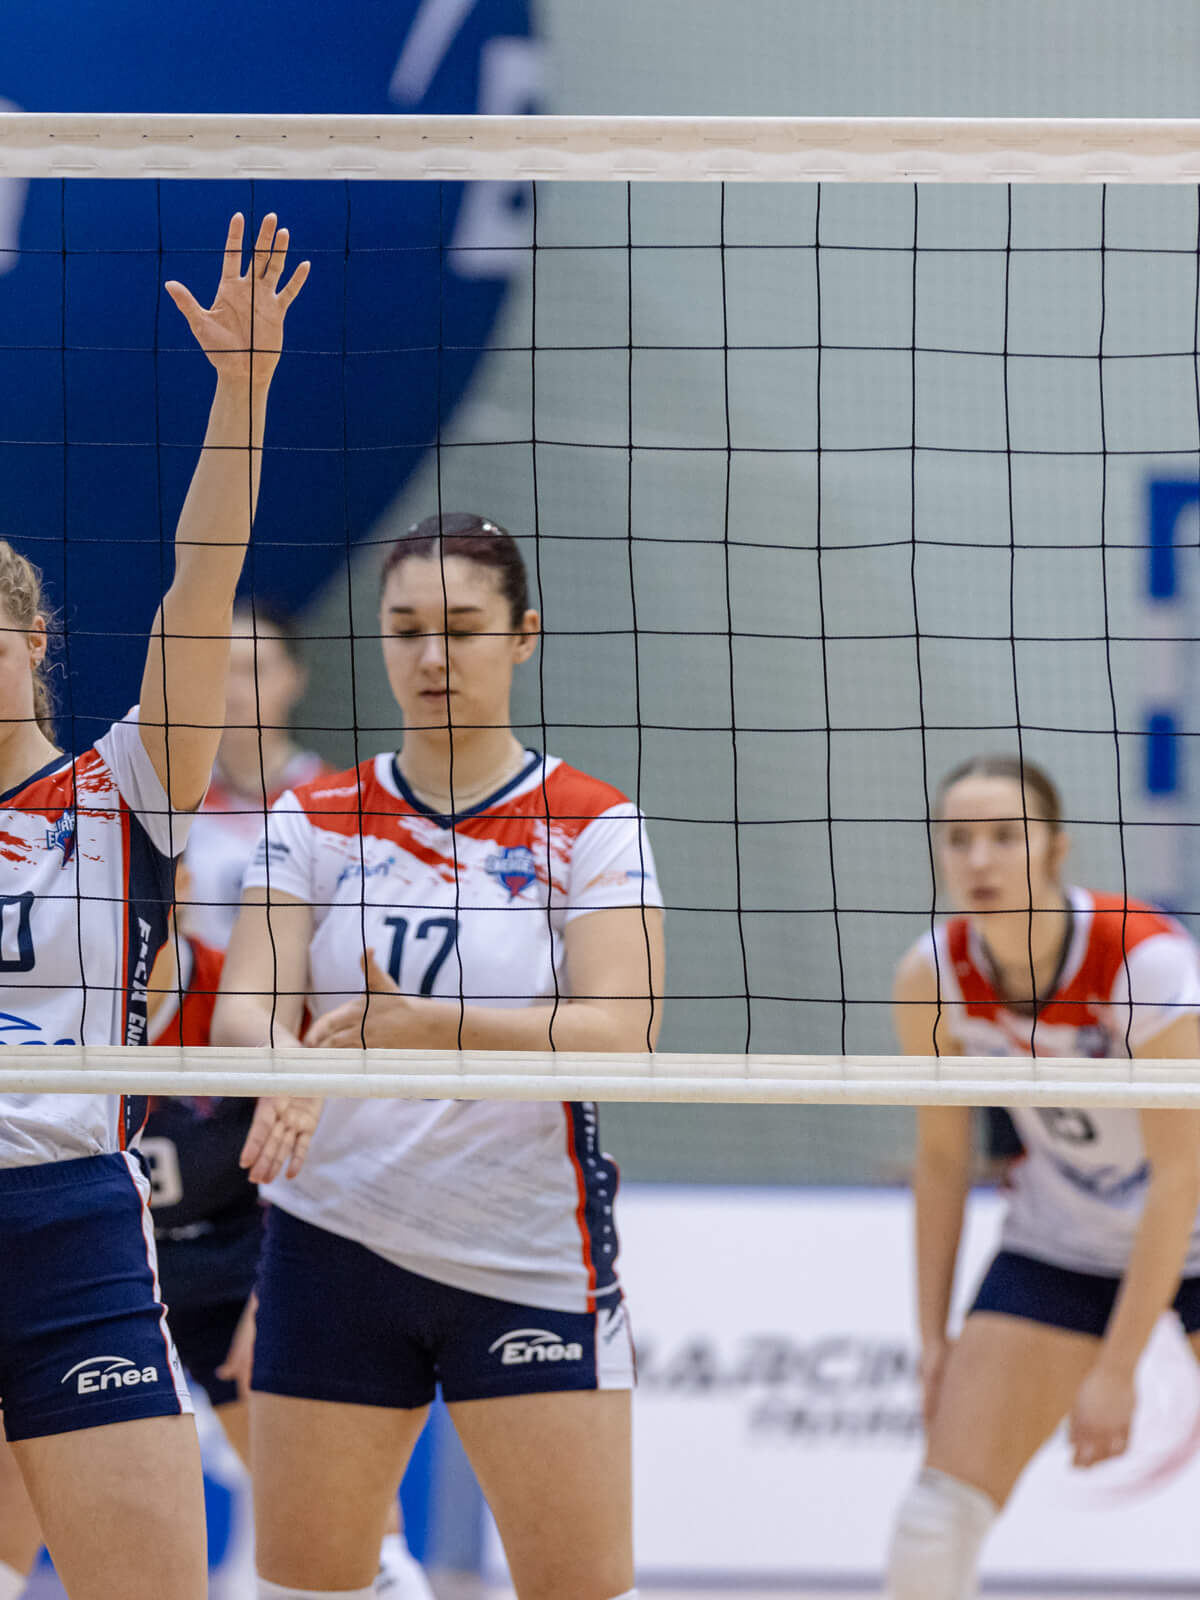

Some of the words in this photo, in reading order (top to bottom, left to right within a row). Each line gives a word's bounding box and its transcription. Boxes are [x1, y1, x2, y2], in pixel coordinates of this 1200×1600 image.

[383, 915, 461, 998] 17
[501, 1341, 583, 1365] Enea
[78, 1366, 159, 1395] Enea
